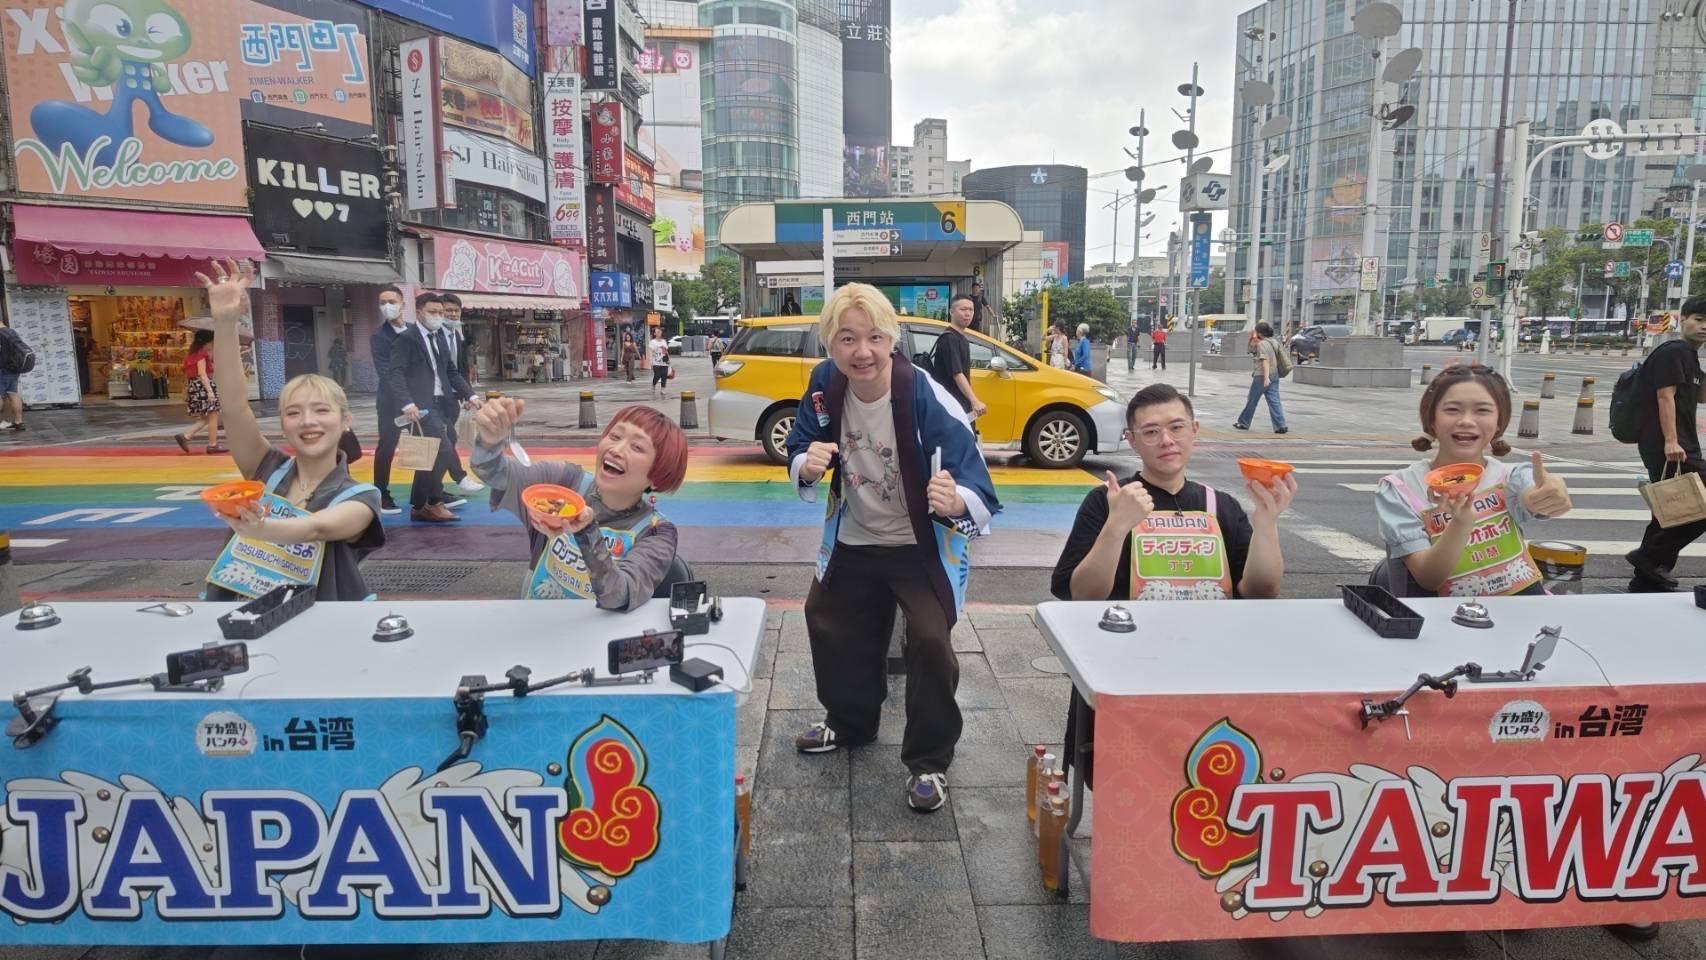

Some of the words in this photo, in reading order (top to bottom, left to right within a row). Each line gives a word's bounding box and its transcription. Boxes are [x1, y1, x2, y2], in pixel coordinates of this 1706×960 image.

[239, 19, 367, 84] 西門町
[551, 98, 574, 136] 按摩
[14, 135, 239, 194] Welcome
[482, 151, 514, 174] Hair
[553, 151, 575, 189] 護膚
[256, 157, 381, 199] KILLER
[846, 210, 895, 226] 西門站
[940, 211, 957, 234] 6
[1145, 517, 1208, 529] TAIWAN
[204, 721, 247, 737] デカ盛り
[1500, 710, 1543, 725] デカ盛り
[0, 787, 569, 921] JAPAN
